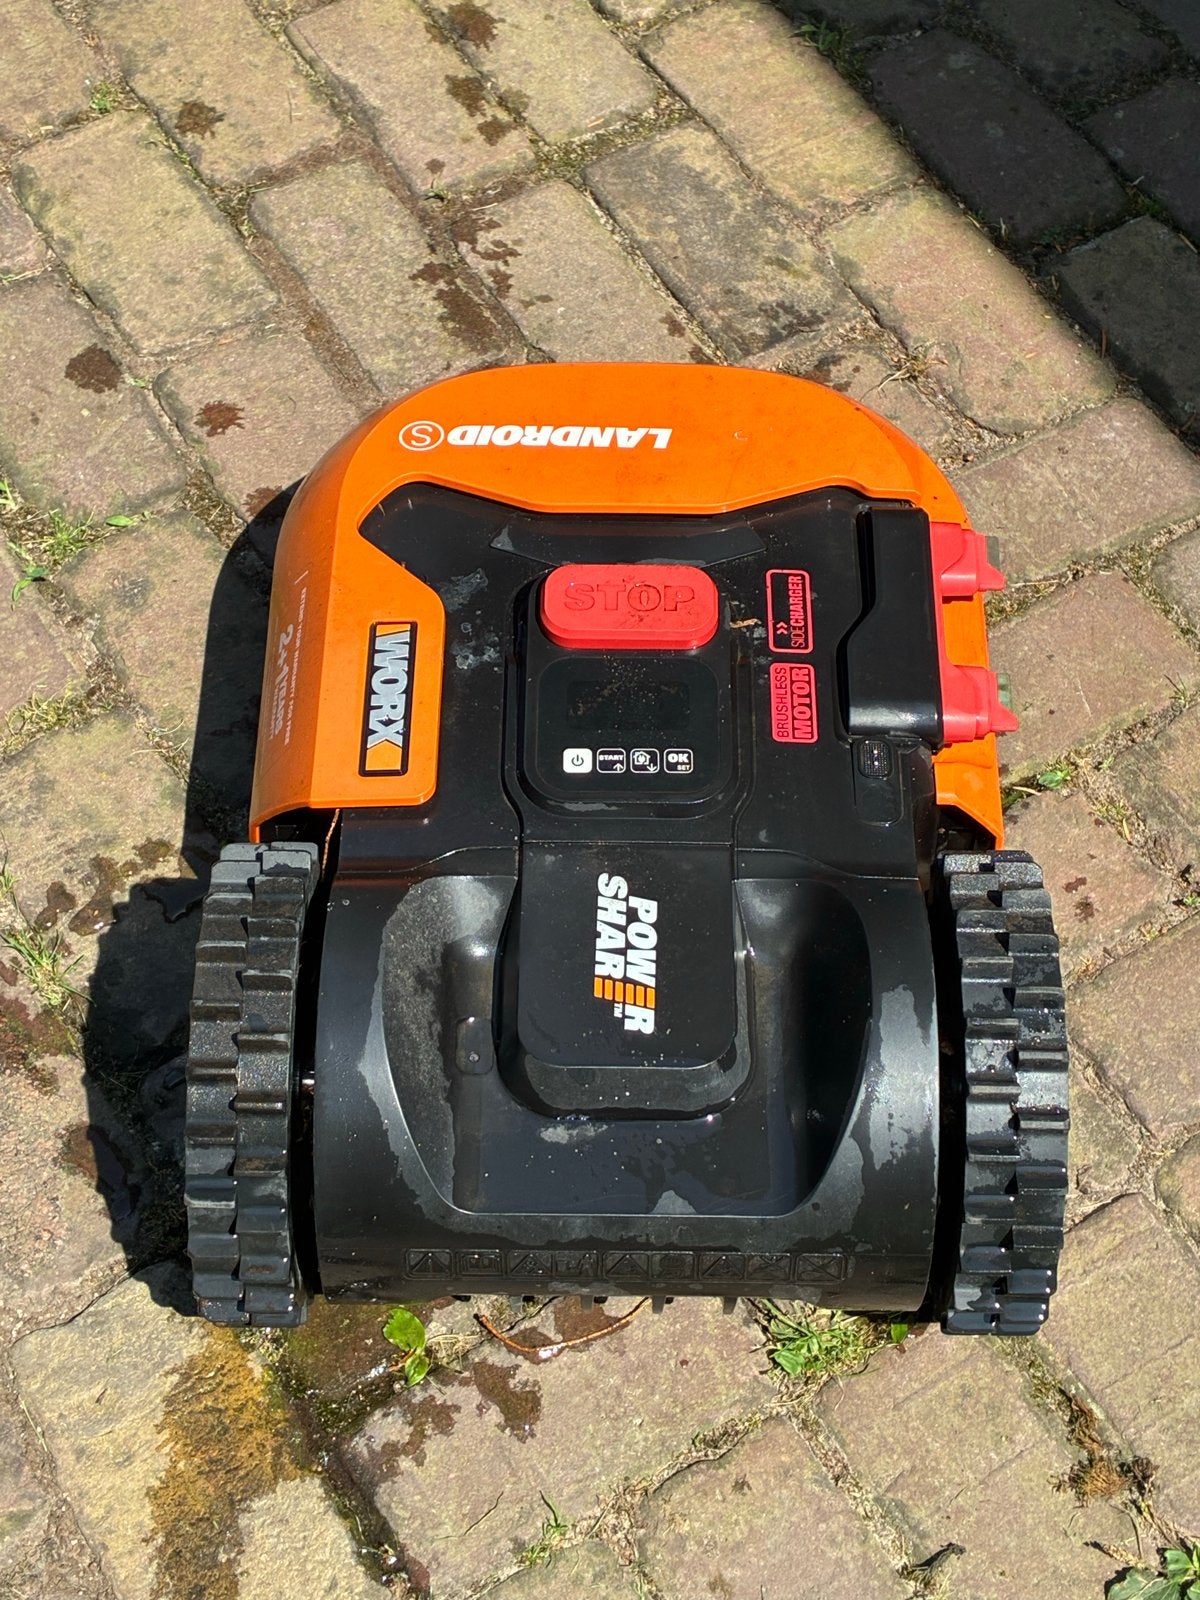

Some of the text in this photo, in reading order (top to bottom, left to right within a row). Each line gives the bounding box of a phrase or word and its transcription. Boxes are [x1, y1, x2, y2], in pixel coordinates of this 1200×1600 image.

[447, 425, 673, 449] LANDROID
[564, 584, 695, 612] STOP
[788, 575, 806, 648] SIDECHARGER
[275, 674, 288, 735] YEARS
[367, 631, 410, 749] WORX
[774, 667, 790, 738] BRUSHLESS
[790, 668, 812, 740] MOTOR
[667, 753, 689, 763] OK
[624, 896, 658, 1035] POWER
